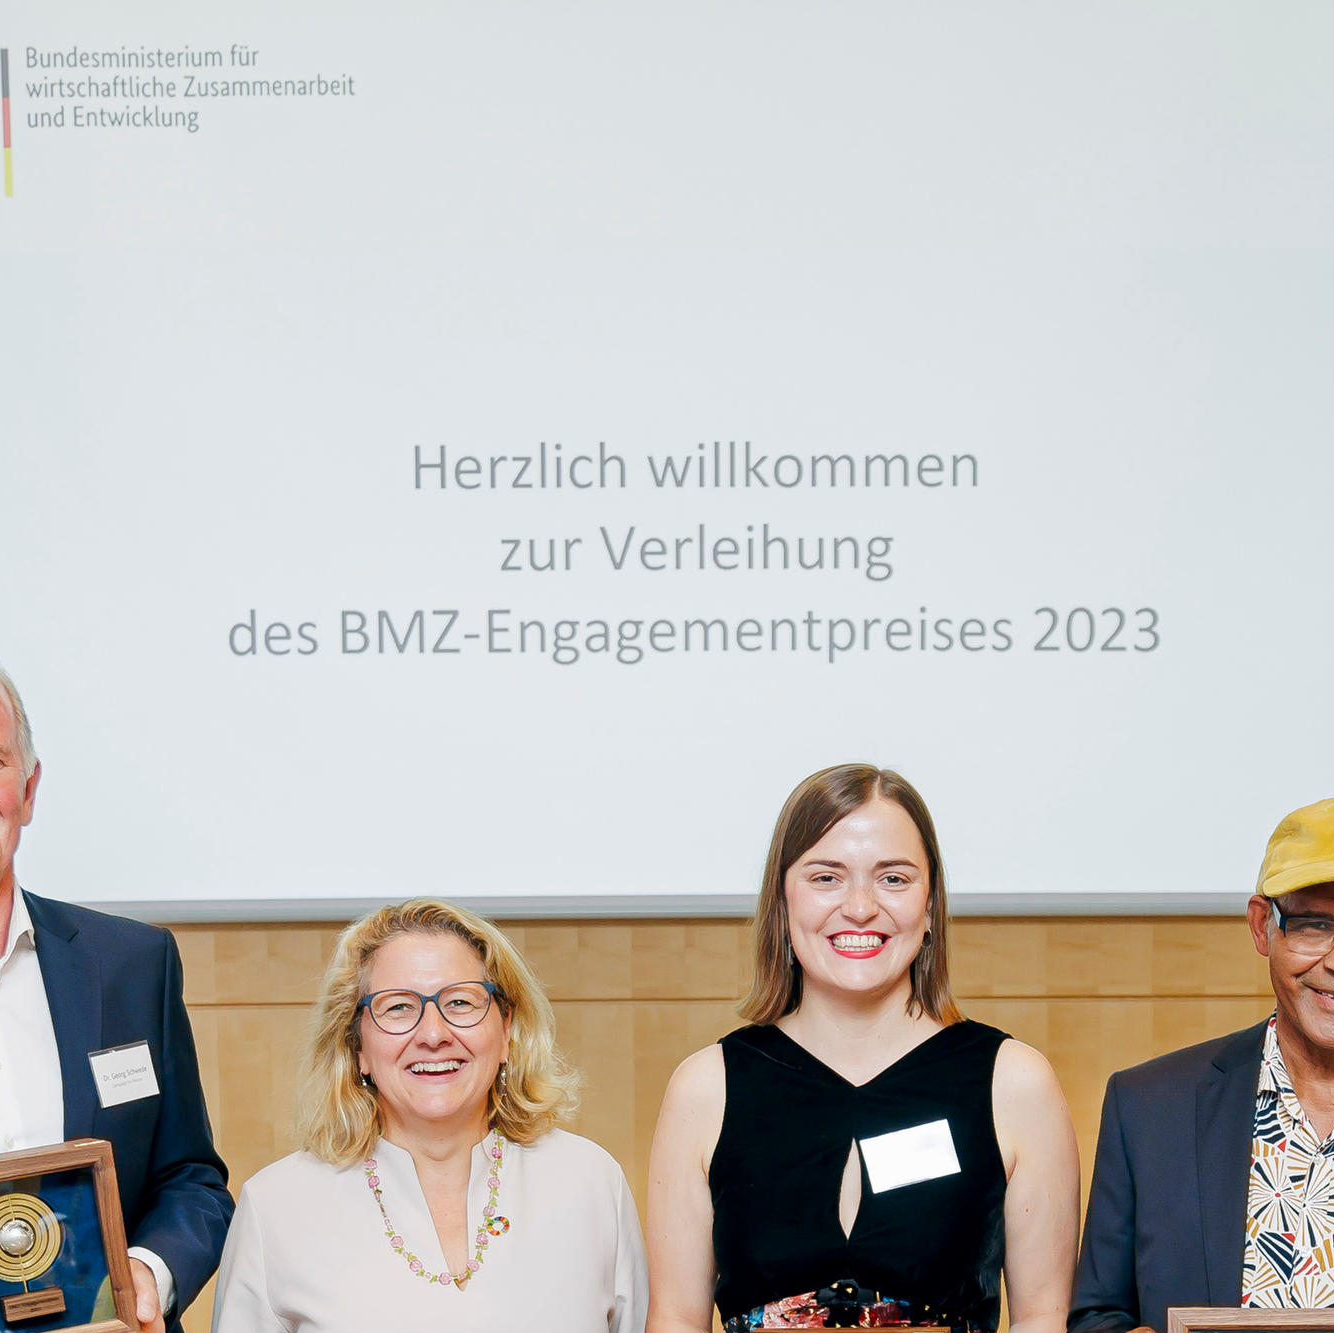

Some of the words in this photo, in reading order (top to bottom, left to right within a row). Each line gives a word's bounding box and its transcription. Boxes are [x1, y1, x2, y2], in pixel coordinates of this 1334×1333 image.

[26, 45, 223, 69] Bundesministerium
[230, 44, 259, 67] für
[26, 75, 177, 99] wirtschaftliche
[183, 73, 356, 98] Zusammenarbeit
[27, 105, 65, 129] und
[73, 105, 200, 133] Entwicklung
[413, 442, 627, 490] Herzlich
[646, 441, 979, 489] willkommen
[500, 537, 583, 572] zur
[599, 523, 895, 582] Verleihung
[228, 609, 319, 657] des
[340, 605, 1014, 666] BMZ-Engagementpreises
[1033, 606, 1162, 653] 2023
